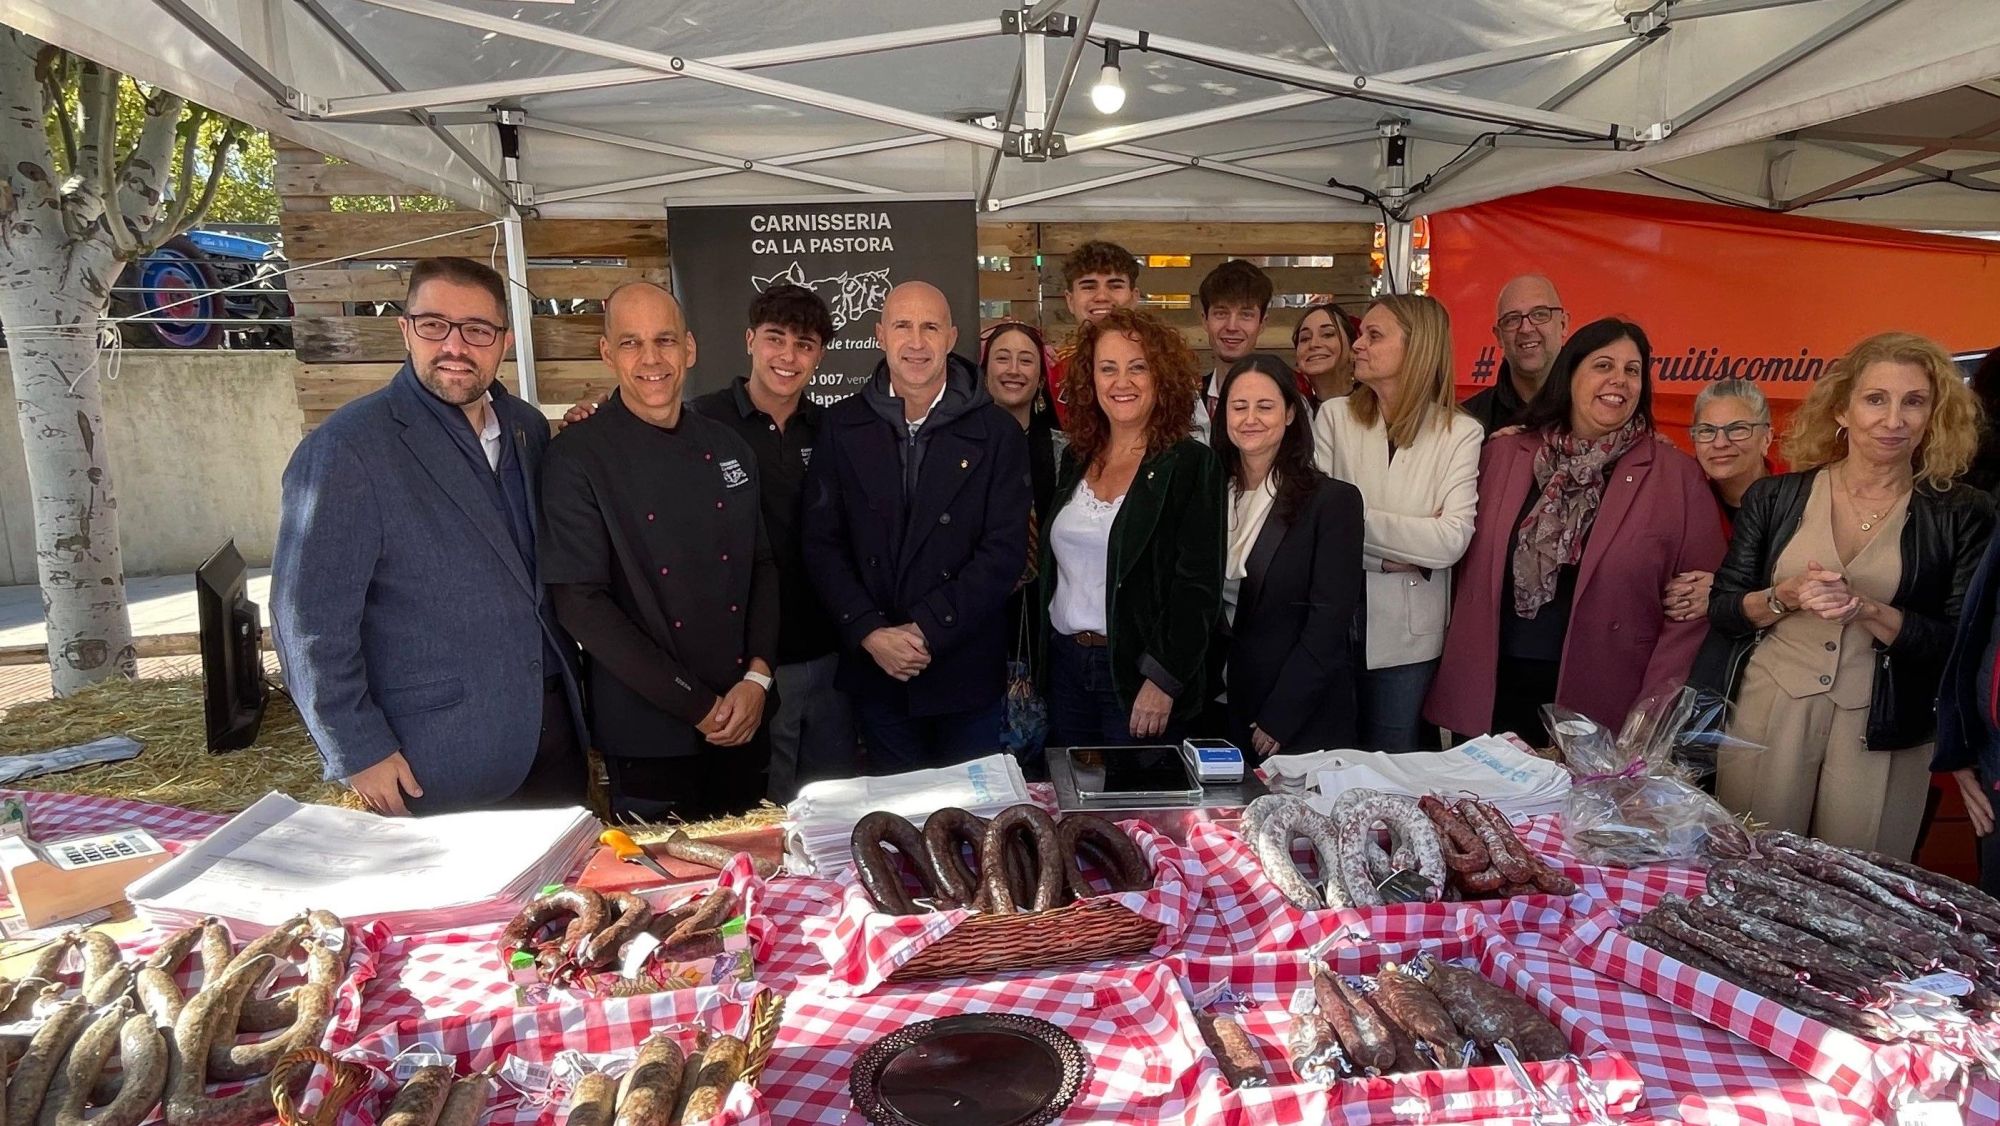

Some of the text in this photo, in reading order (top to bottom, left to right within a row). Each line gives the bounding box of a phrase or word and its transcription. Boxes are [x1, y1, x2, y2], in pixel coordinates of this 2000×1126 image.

[750, 212, 892, 232] CARNISSERIA
[751, 237, 894, 254] CA LA PASTORA
[826, 337, 843, 350] de
[1649, 346, 1840, 382] ruitiscomin
[819, 373, 844, 386] 007
